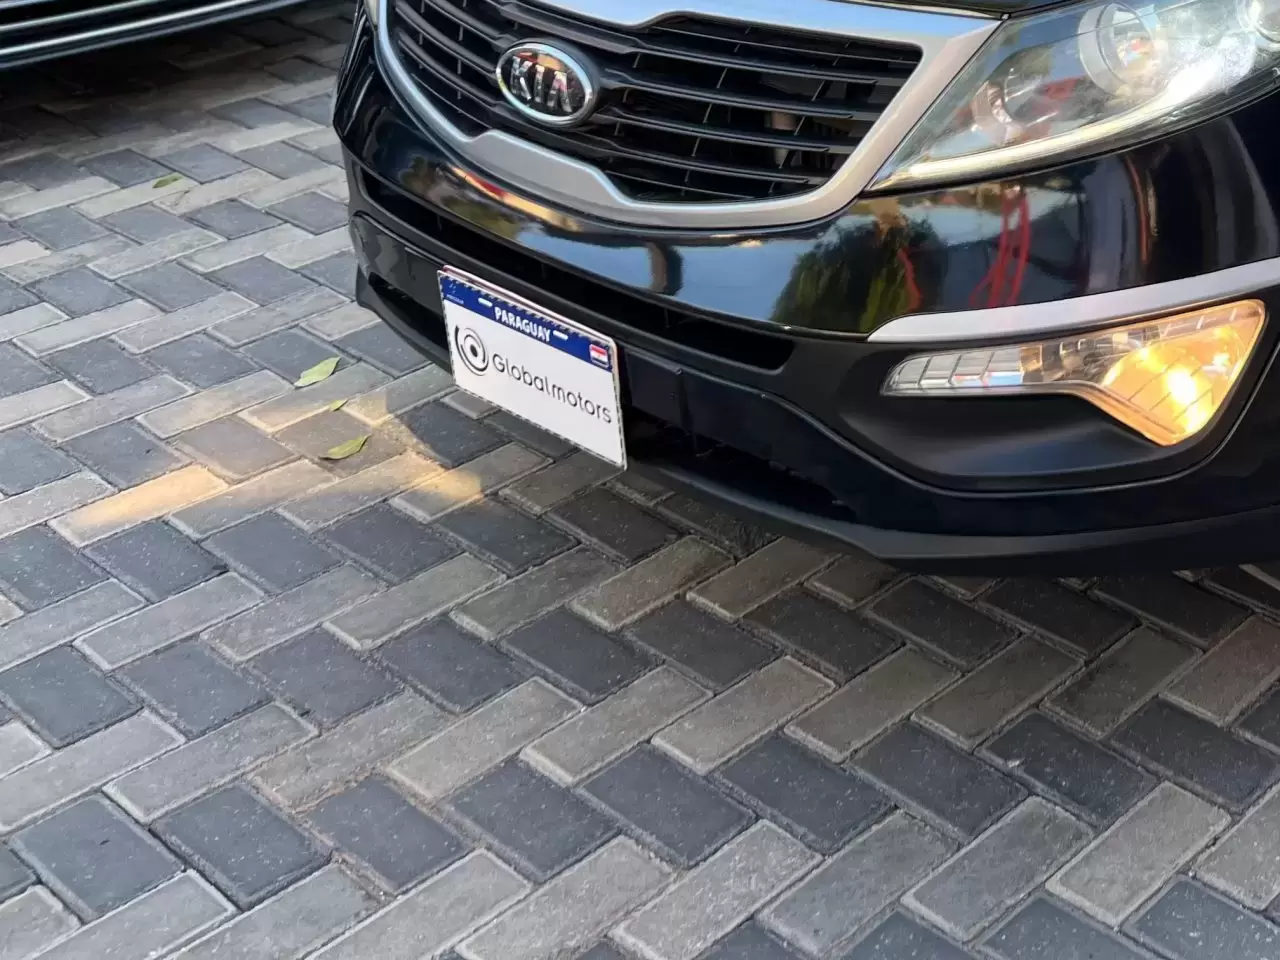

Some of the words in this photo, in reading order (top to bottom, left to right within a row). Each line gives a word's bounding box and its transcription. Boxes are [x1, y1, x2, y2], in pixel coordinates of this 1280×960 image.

[510, 54, 573, 114] KIA
[494, 305, 551, 343] PARAGUAY
[491, 352, 613, 425] Globalmotors
